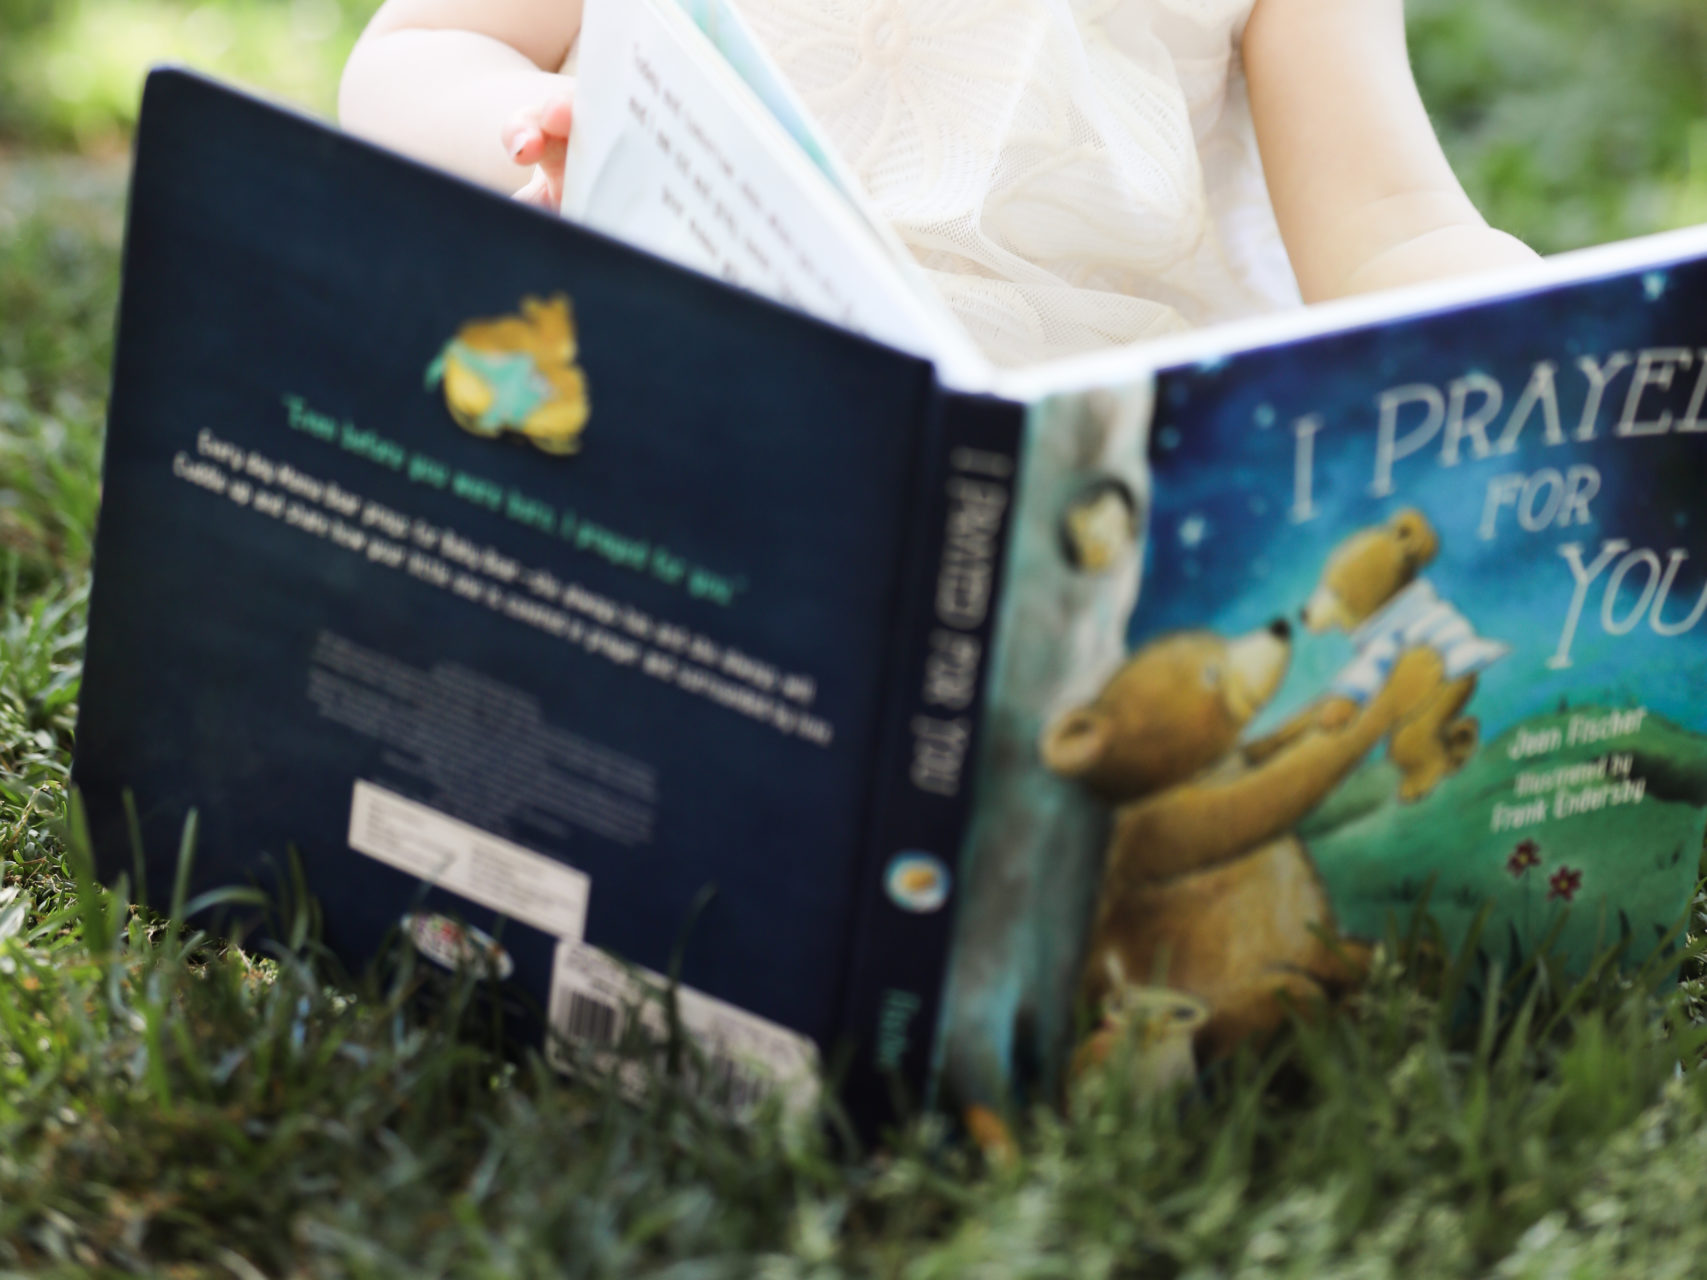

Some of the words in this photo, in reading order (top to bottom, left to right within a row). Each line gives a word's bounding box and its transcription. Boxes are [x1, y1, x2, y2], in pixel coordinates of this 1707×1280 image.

[1290, 411, 1326, 524] I
[1476, 464, 1601, 541] FOR
[934, 474, 1009, 630] PRAYED
[1546, 537, 1707, 670] YOU
[920, 626, 982, 712] FOR
[909, 713, 972, 798] YOU
[1508, 725, 1562, 761] Jean
[1566, 705, 1647, 747] Fischer
[1514, 753, 1608, 798] Illustrated
[1608, 752, 1633, 780] by
[1490, 797, 1548, 834] Frank
[1553, 776, 1646, 820] Endersby
